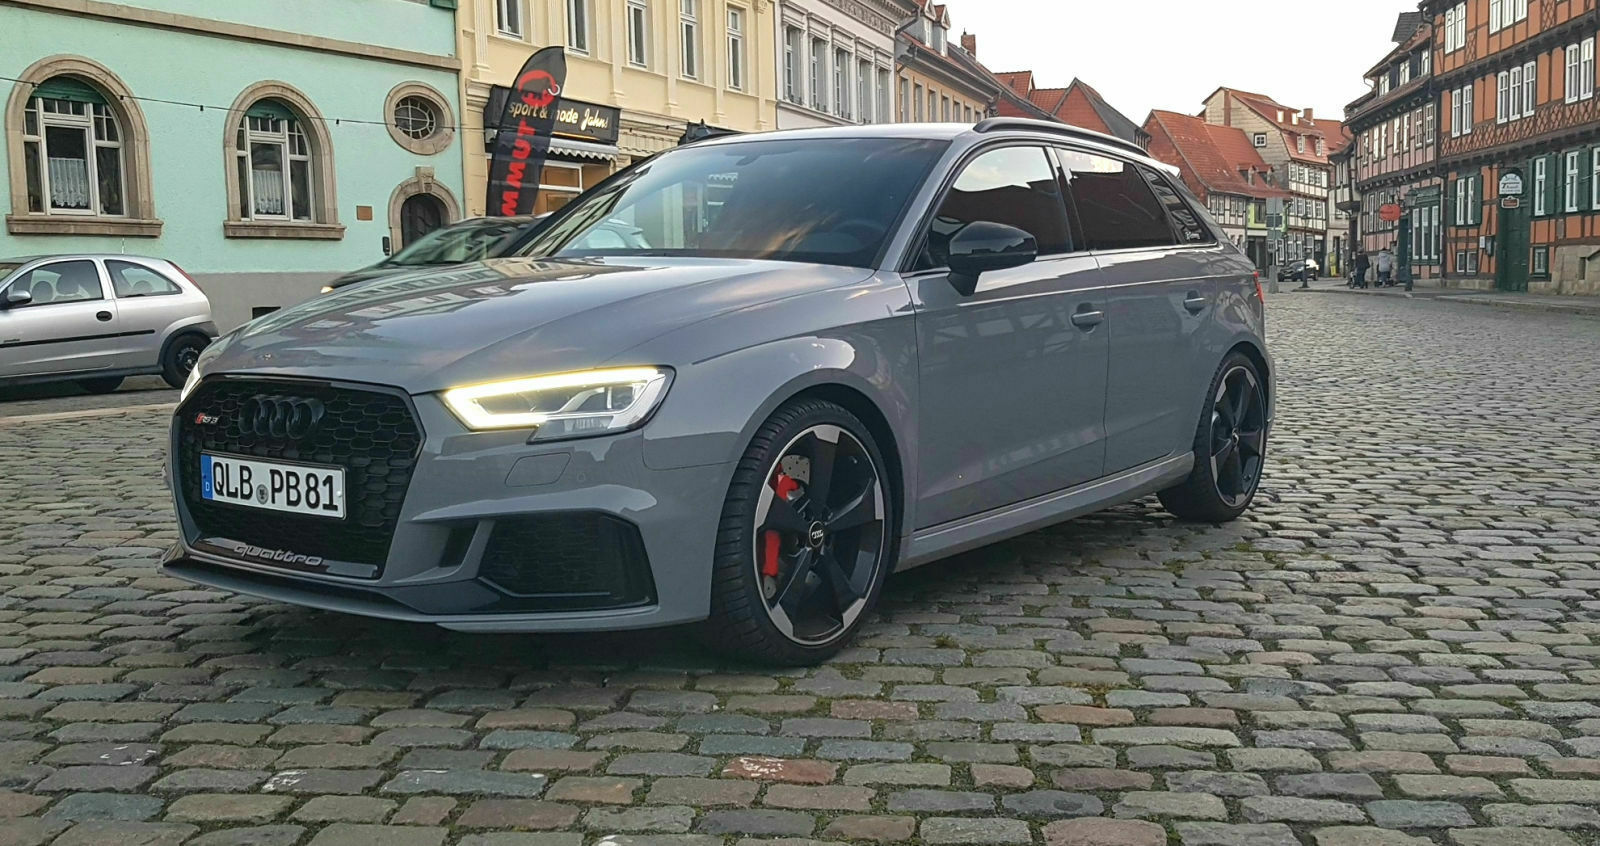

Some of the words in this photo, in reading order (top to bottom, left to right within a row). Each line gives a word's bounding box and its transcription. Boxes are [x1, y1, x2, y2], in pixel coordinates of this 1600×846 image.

[508, 102, 538, 118] sport
[213, 461, 254, 500] QLB
[234, 544, 322, 566] quattro
